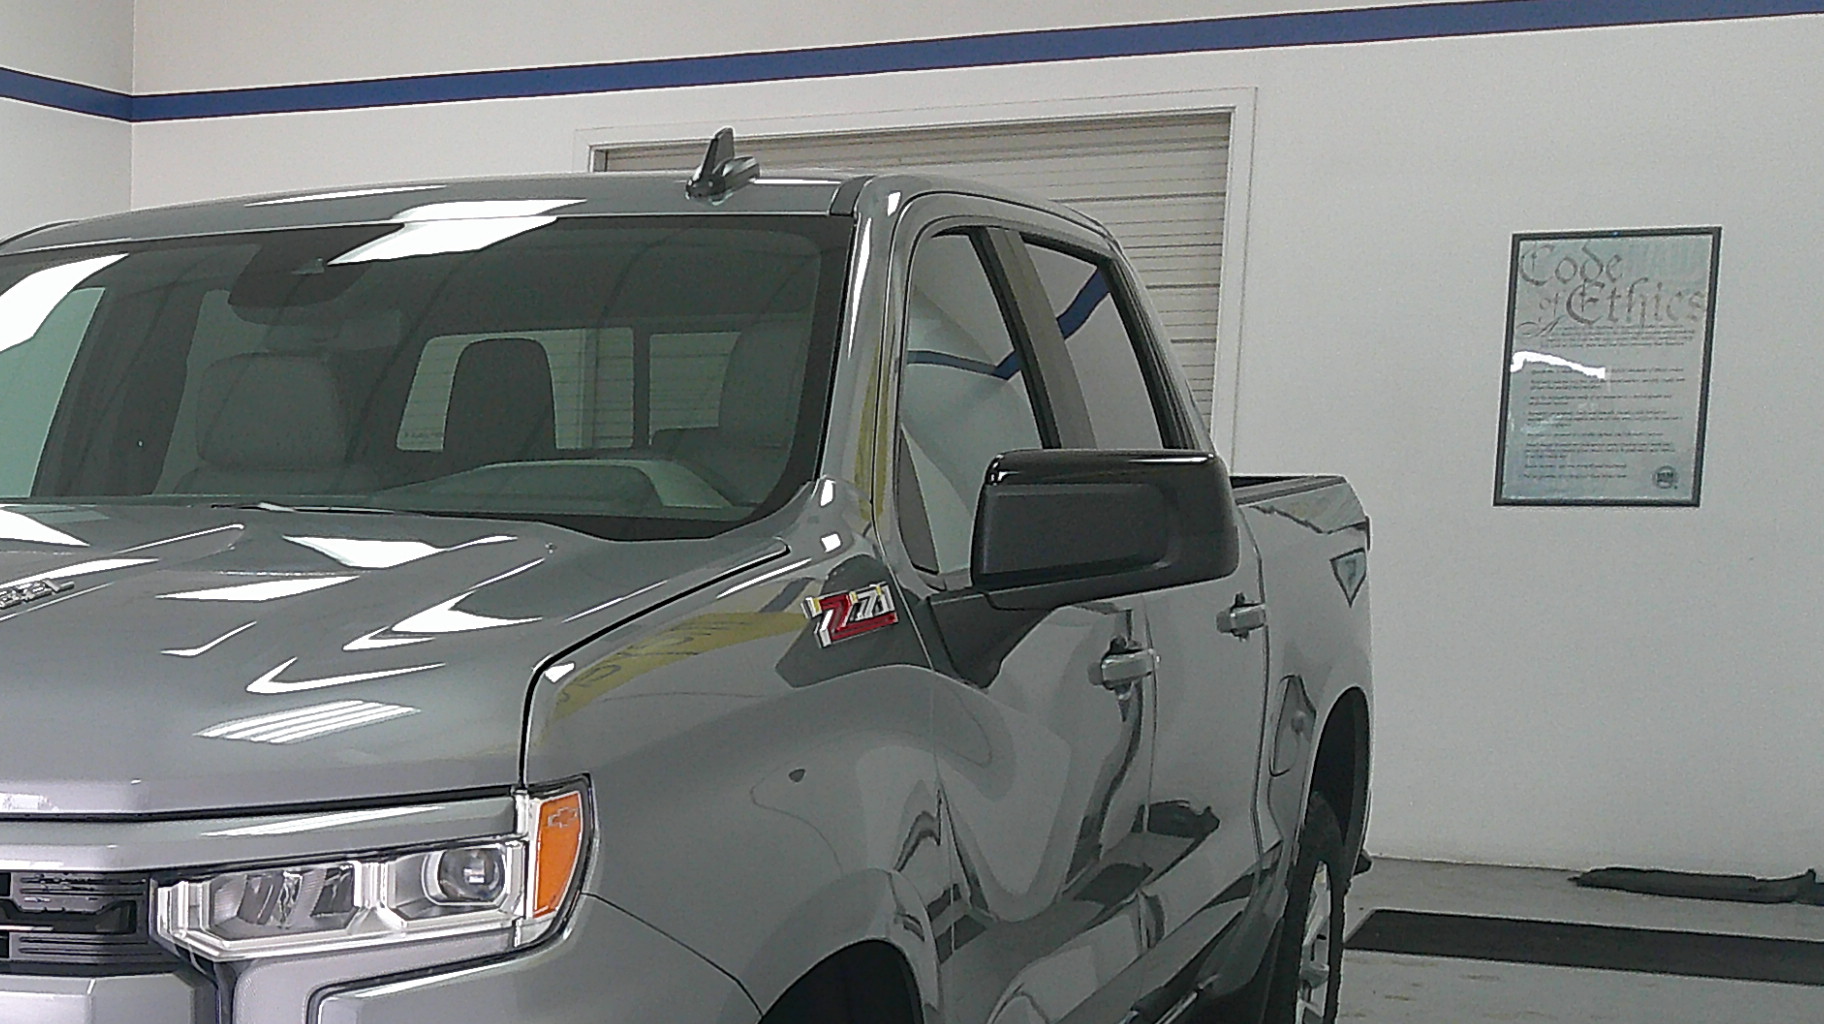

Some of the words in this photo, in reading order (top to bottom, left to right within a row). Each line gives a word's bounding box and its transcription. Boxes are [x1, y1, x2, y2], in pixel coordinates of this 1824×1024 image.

[1519, 241, 1623, 287] Code
[1539, 293, 1560, 322] of
[1566, 277, 1707, 328] Ethics
[800, 581, 899, 648] Z71
